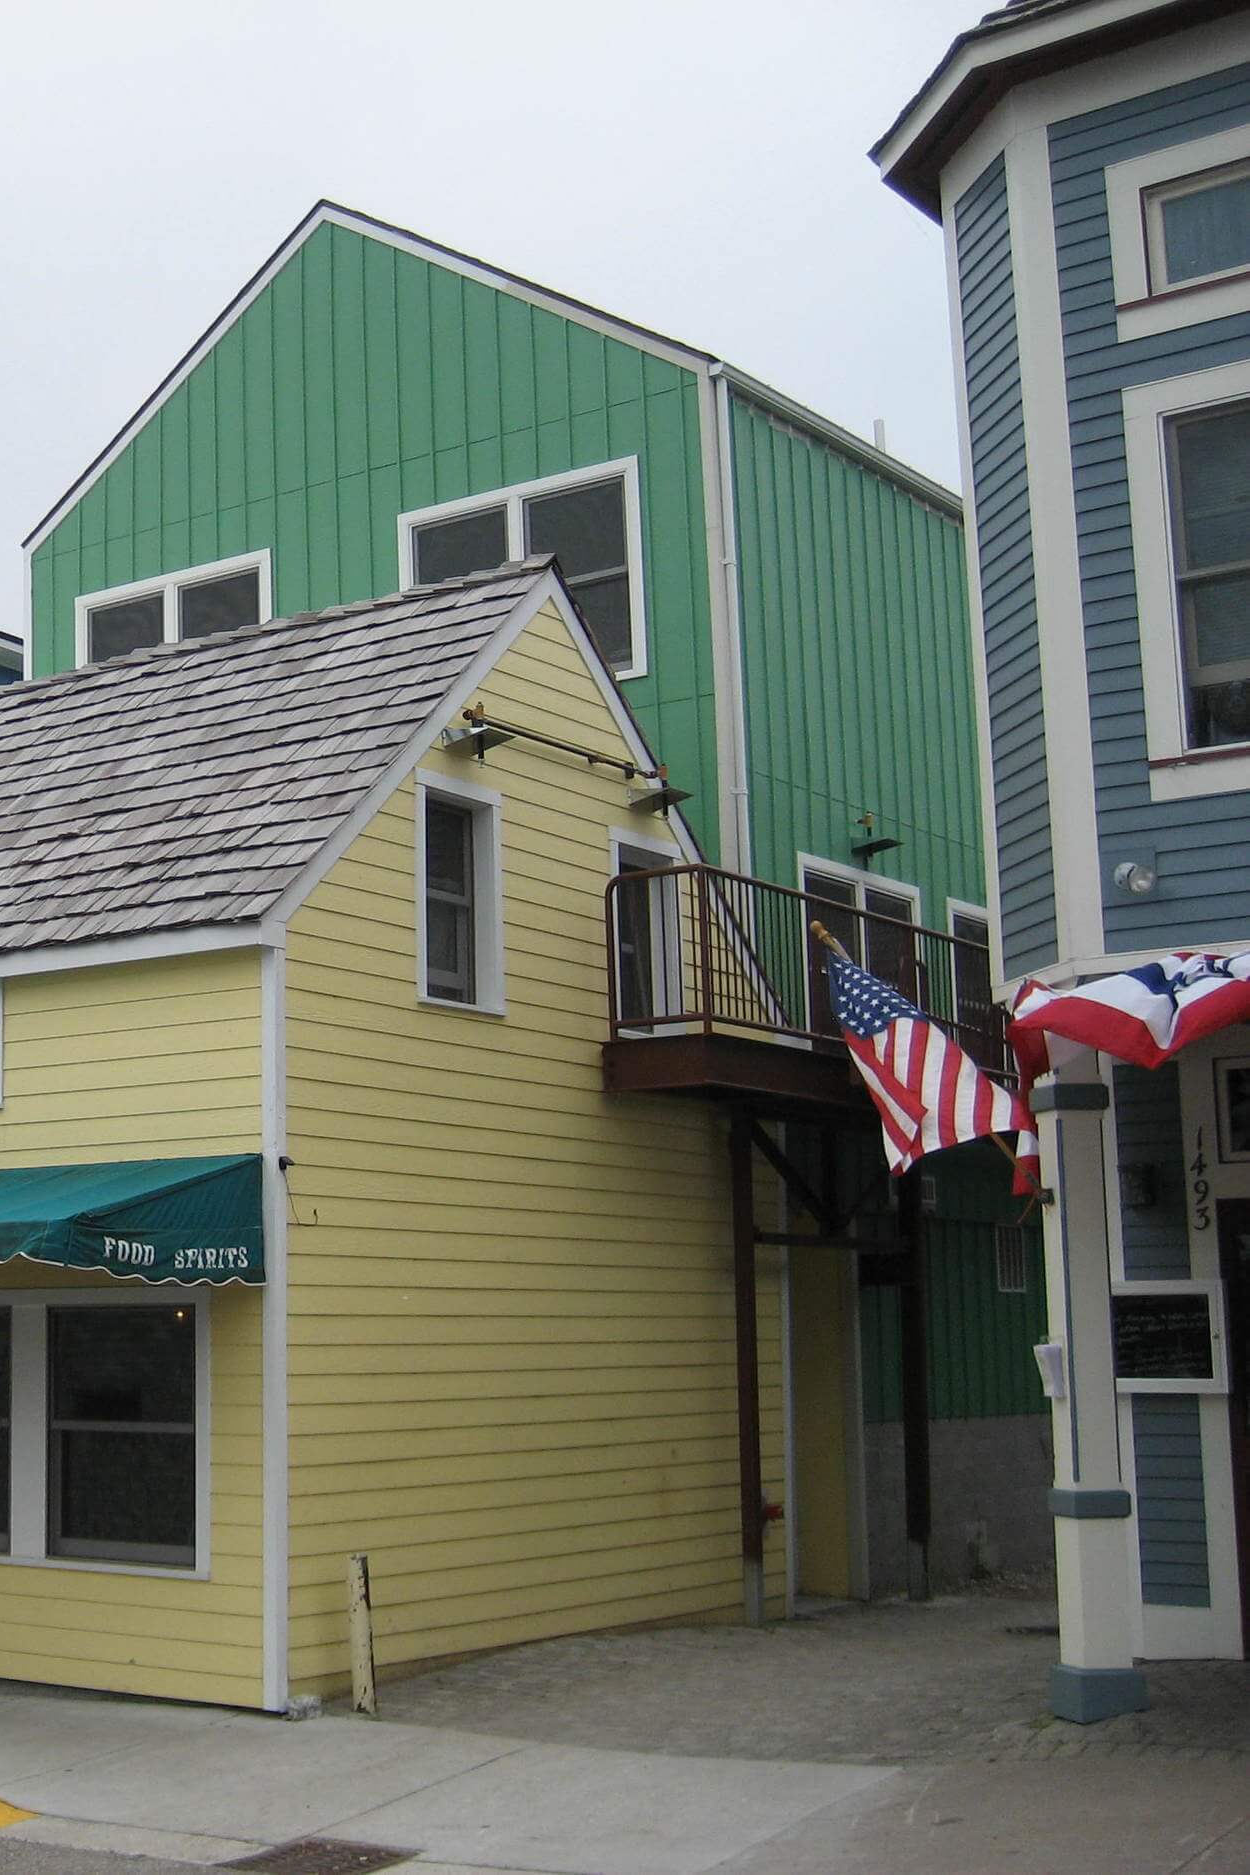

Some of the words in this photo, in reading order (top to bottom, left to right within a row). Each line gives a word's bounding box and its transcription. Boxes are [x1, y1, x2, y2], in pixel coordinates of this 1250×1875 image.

[1190, 1126, 1210, 1231] 1493
[103, 1236, 155, 1266] FOOD
[174, 1246, 249, 1269] SPIRITS
